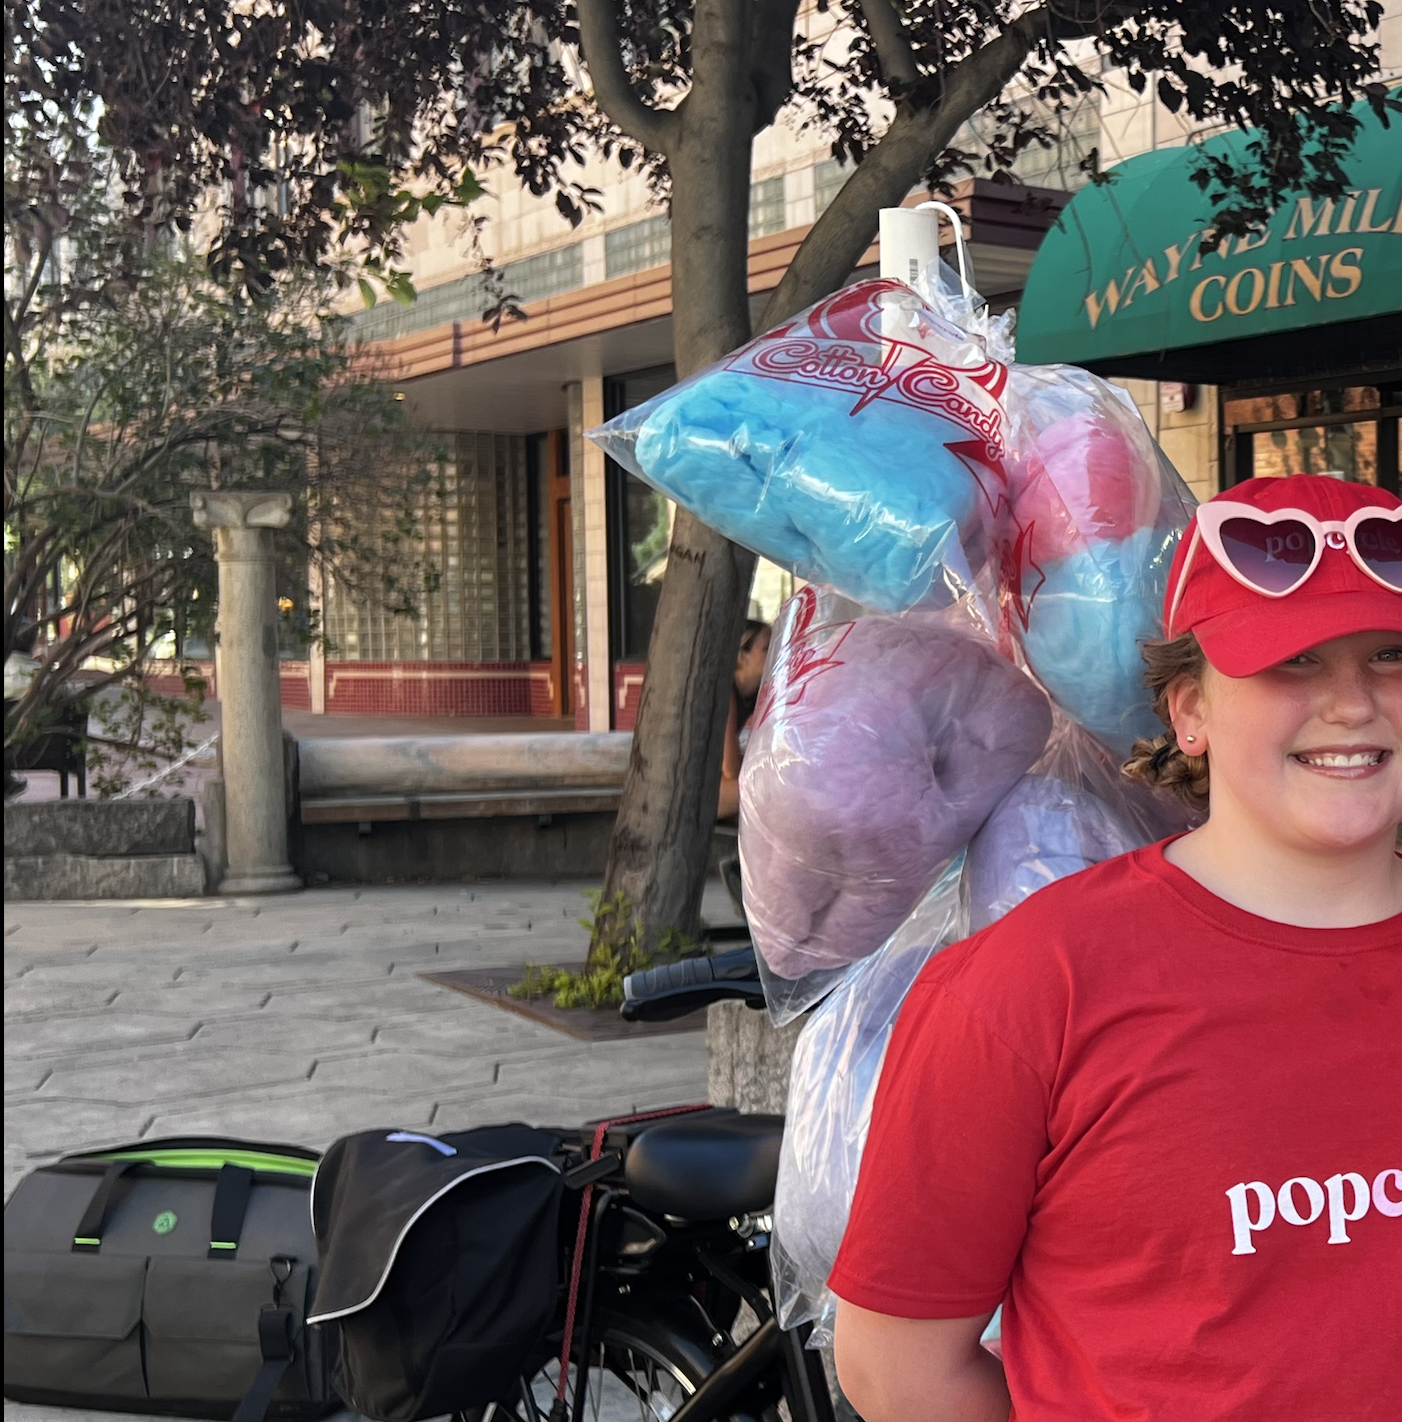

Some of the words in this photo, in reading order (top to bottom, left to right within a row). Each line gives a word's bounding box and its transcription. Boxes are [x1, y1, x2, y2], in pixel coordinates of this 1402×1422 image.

[1189, 247, 1364, 323] COINS
[752, 339, 889, 389] Cotton
[897, 366, 1005, 461] Candy
